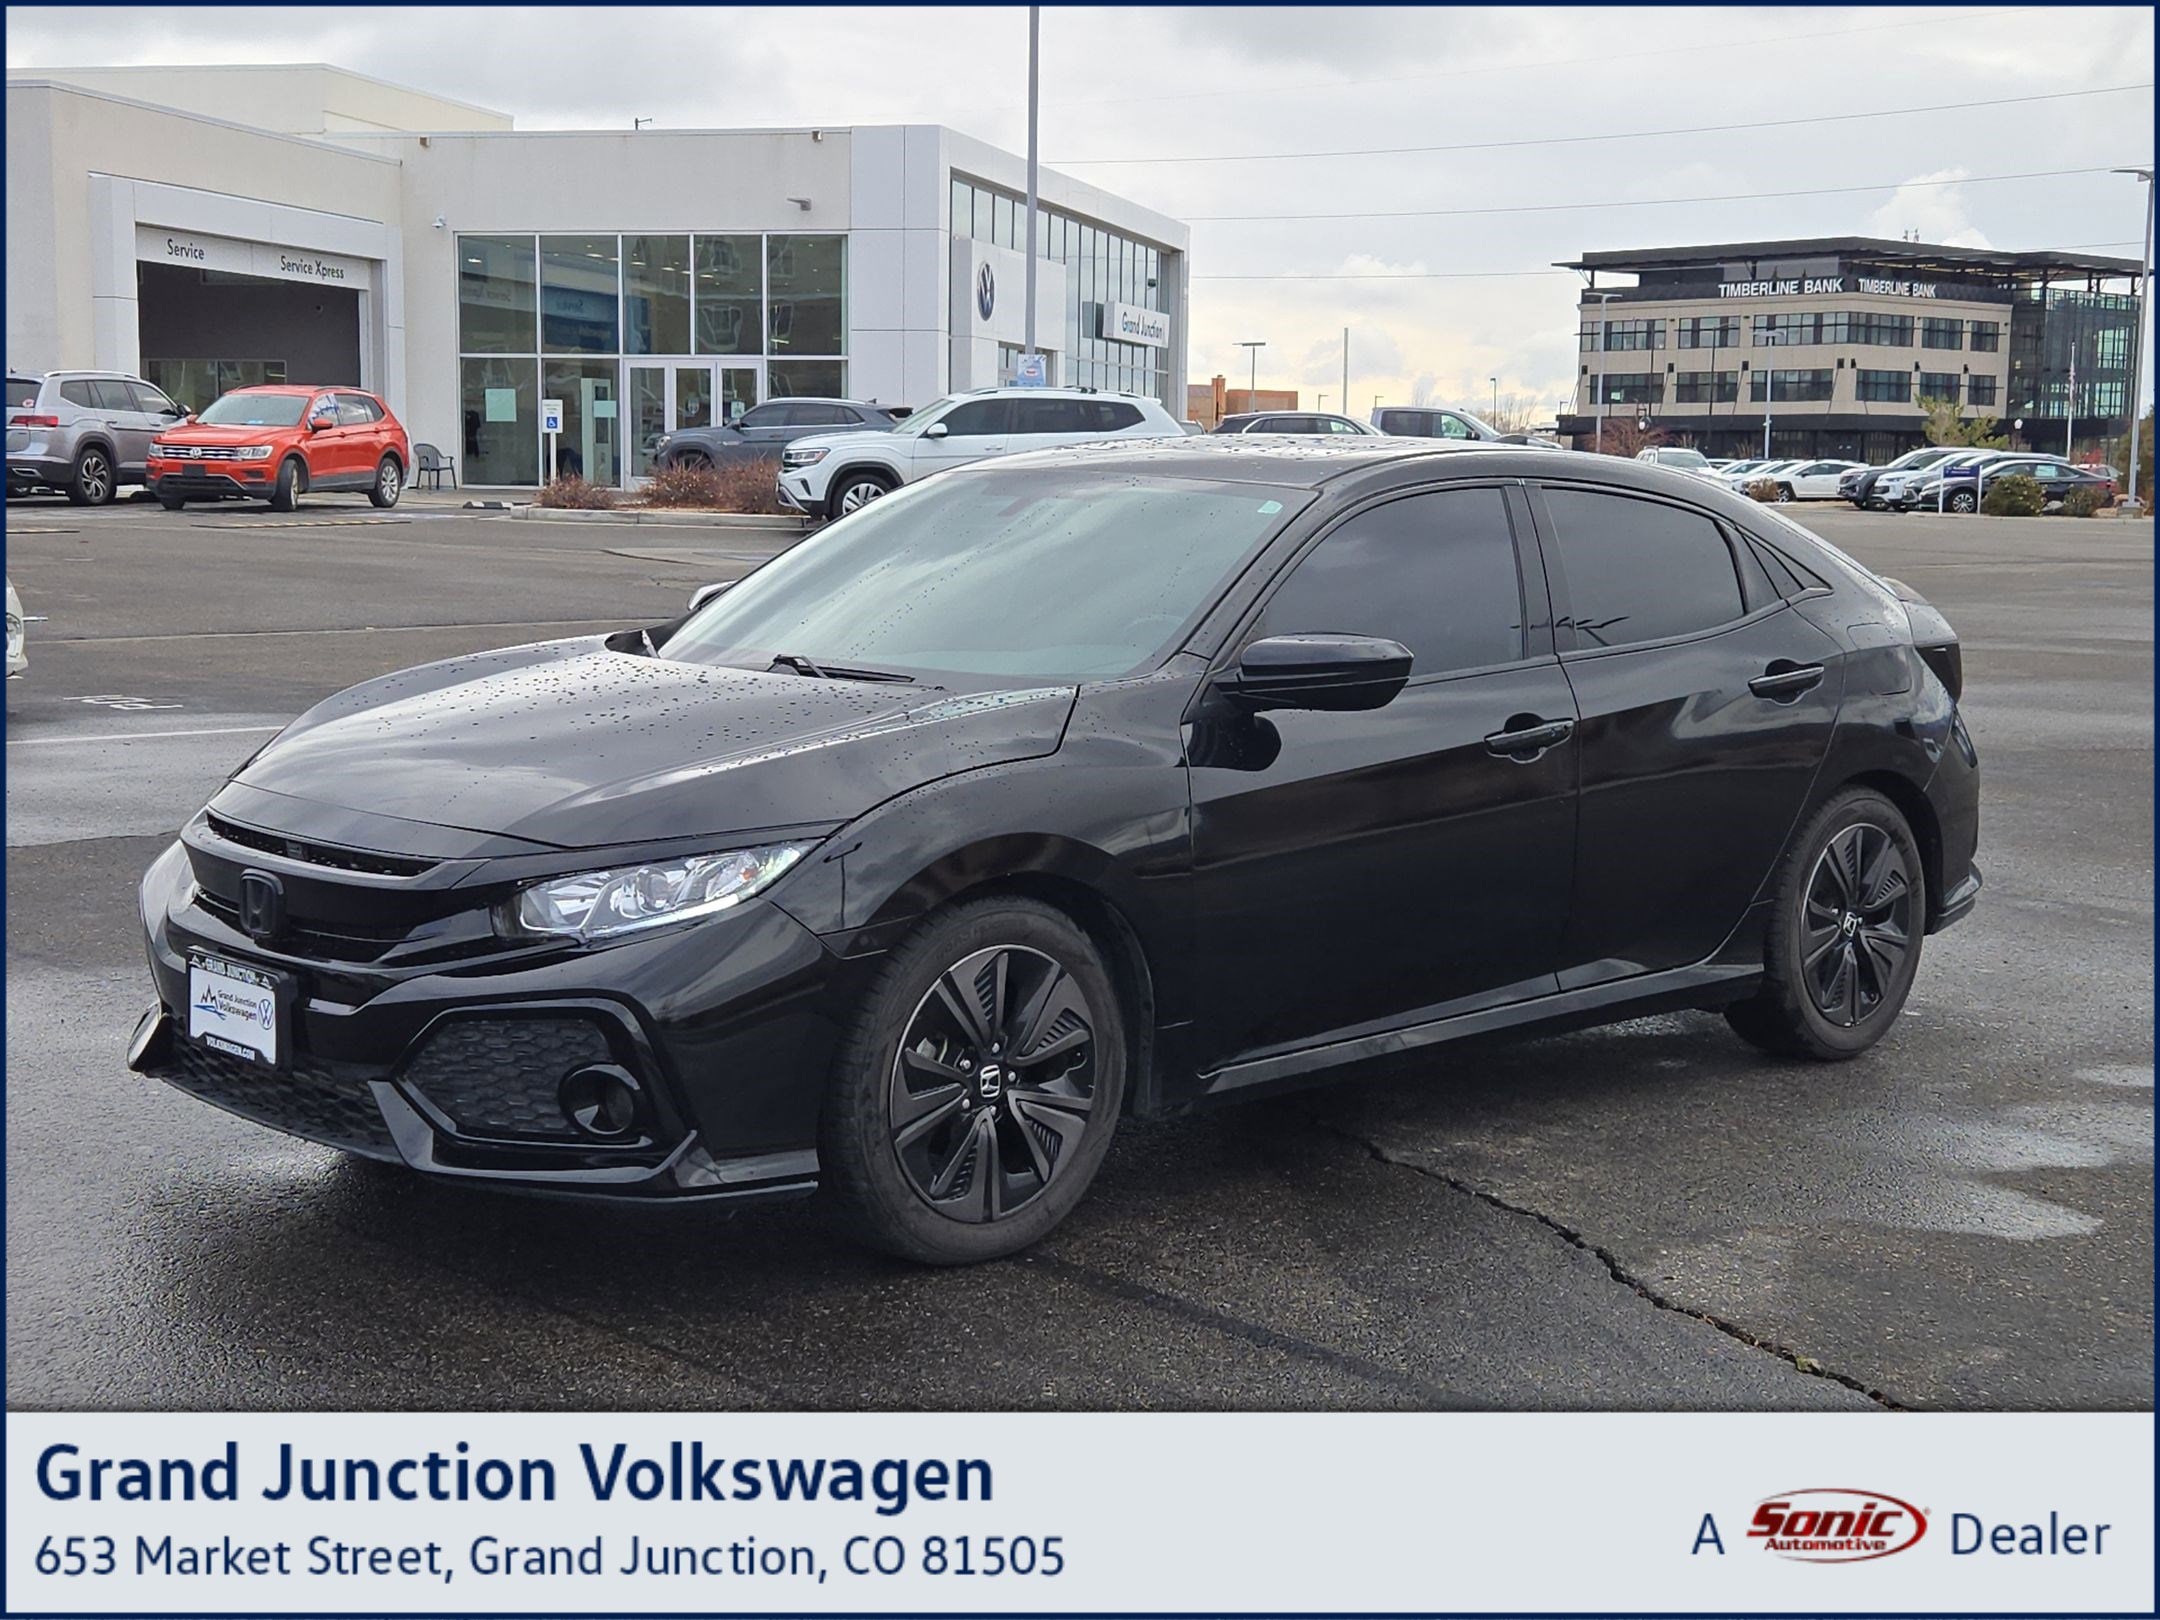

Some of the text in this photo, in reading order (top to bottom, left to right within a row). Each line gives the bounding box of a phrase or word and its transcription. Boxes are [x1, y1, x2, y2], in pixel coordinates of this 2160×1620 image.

[167, 239, 205, 260] Service
[281, 255, 344, 280] Service Xpress
[1718, 278, 1843, 298] TIMBERLINE BANK
[1858, 278, 1937, 298] TIMBERLINE BANK
[1122, 311, 1163, 339] Grand Junction
[217, 989, 257, 1009] Grand Junction
[218, 999, 257, 1021] Volkswagen
